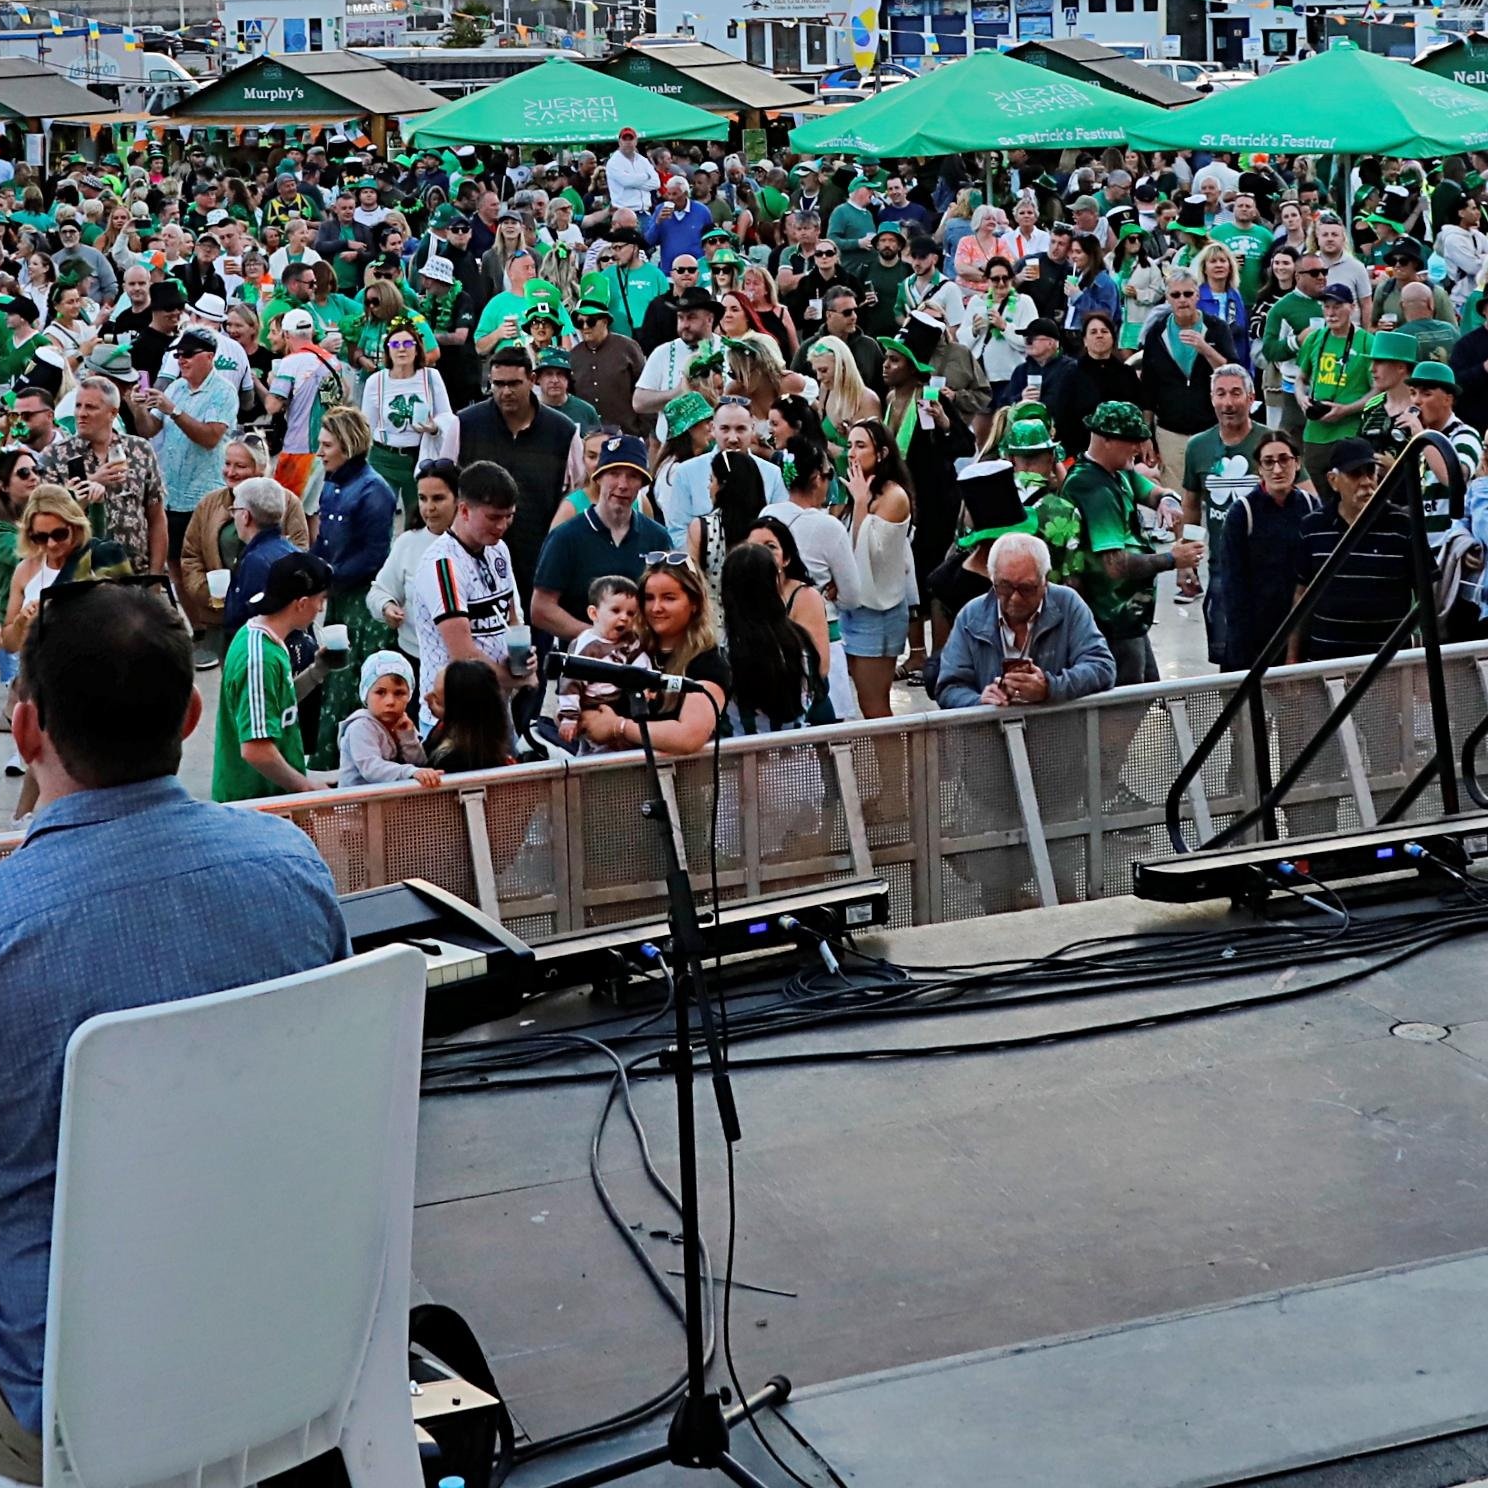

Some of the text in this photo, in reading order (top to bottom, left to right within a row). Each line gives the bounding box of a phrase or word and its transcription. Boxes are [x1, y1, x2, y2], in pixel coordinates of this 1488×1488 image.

[354, 1, 398, 13] MARKE
[244, 87, 304, 102] Murphy's
[1018, 130, 1073, 145] Patrick's
[1075, 126, 1126, 141] Festival
[1219, 132, 1279, 147] Patrick's
[1280, 133, 1337, 149] Festival
[1320, 356, 1335, 372] 10
[1318, 372, 1345, 387] MILE
